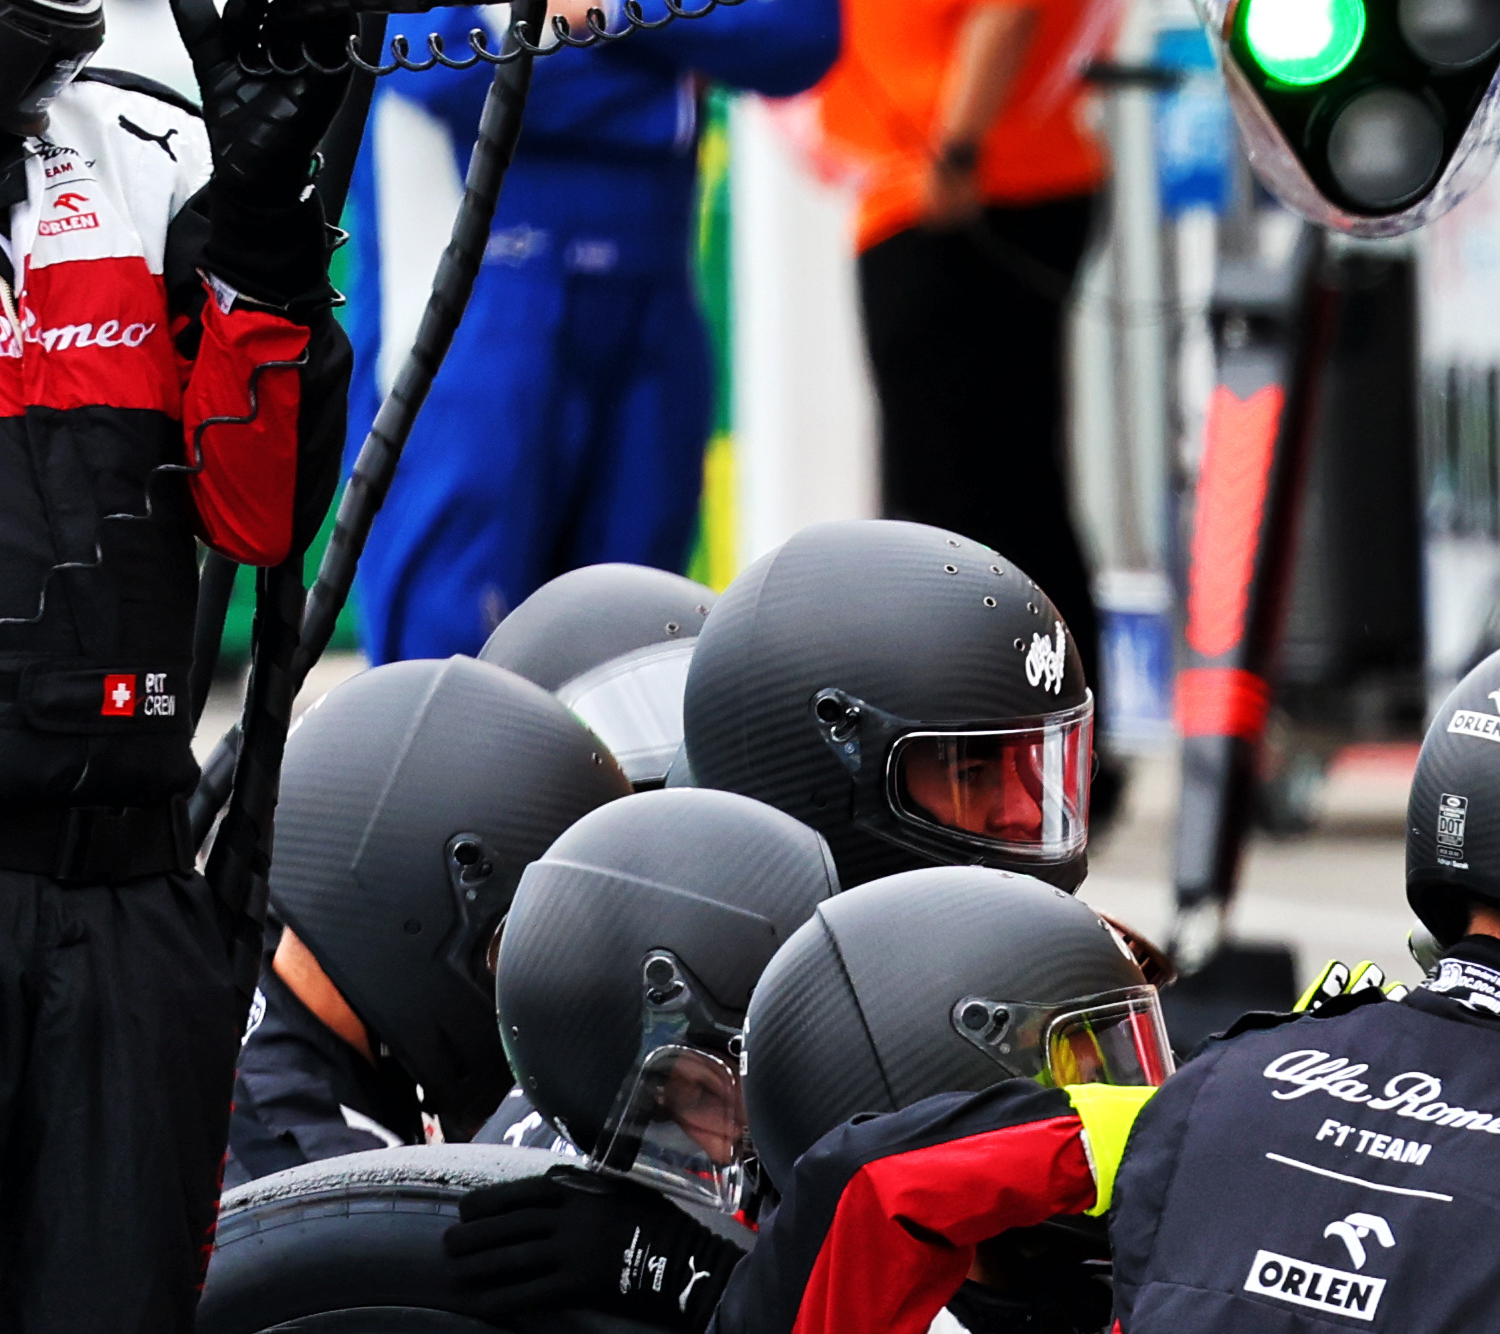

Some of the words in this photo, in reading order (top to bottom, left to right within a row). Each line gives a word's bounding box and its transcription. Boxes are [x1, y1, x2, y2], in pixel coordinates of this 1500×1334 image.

[44, 162, 74, 178] EAM
[39, 217, 95, 235] ORLEN
[145, 672, 167, 694] PIT
[144, 695, 175, 716] CREW
[1440, 818, 1462, 835] DOT
[1263, 1049, 1372, 1100] Alfa
[1315, 1118, 1352, 1147] F1
[1355, 1129, 1432, 1166] TEAM
[1258, 1260, 1374, 1312] ORLEN
